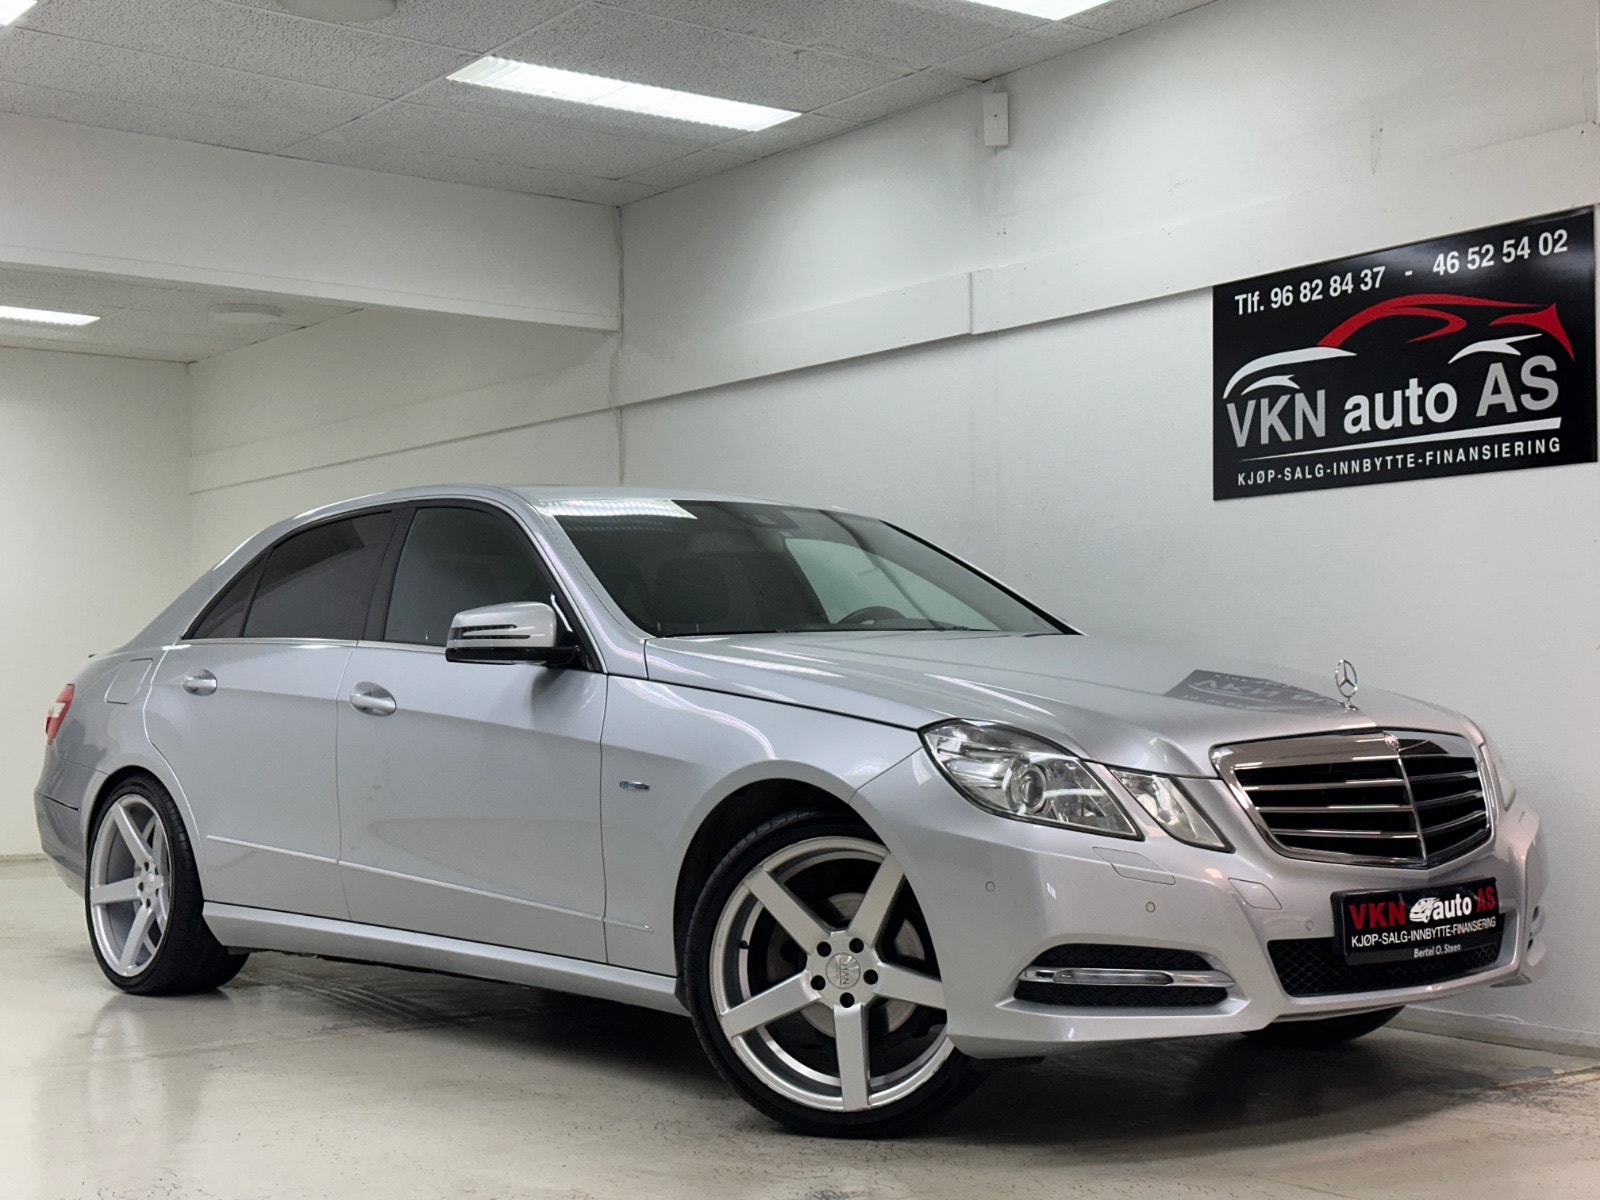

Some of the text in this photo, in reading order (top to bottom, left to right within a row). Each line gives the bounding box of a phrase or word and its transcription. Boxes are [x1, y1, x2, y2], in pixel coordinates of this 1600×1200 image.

[1235, 291, 1265, 315] Tlf.
[1270, 285, 1293, 308] 96
[1300, 279, 1323, 302] 82
[1329, 272, 1354, 297] 84
[1360, 265, 1386, 291] 37
[1433, 251, 1460, 277] 46
[1467, 244, 1495, 270] 52
[1502, 236, 1530, 263] 54
[1538, 229, 1568, 256] 02
[1227, 355, 1559, 448] VKN auto AS
[1237, 437, 1561, 486] KJØP-SALG-INNBYTTE-FINANSIERING
[1350, 886, 1495, 930] VKN auto AS
[1351, 916, 1497, 948] KJØP-SALG-INNBYTTE-FINANSIERING
[1435, 945, 1443, 955] O.
[1444, 943, 1461, 954] Steen
